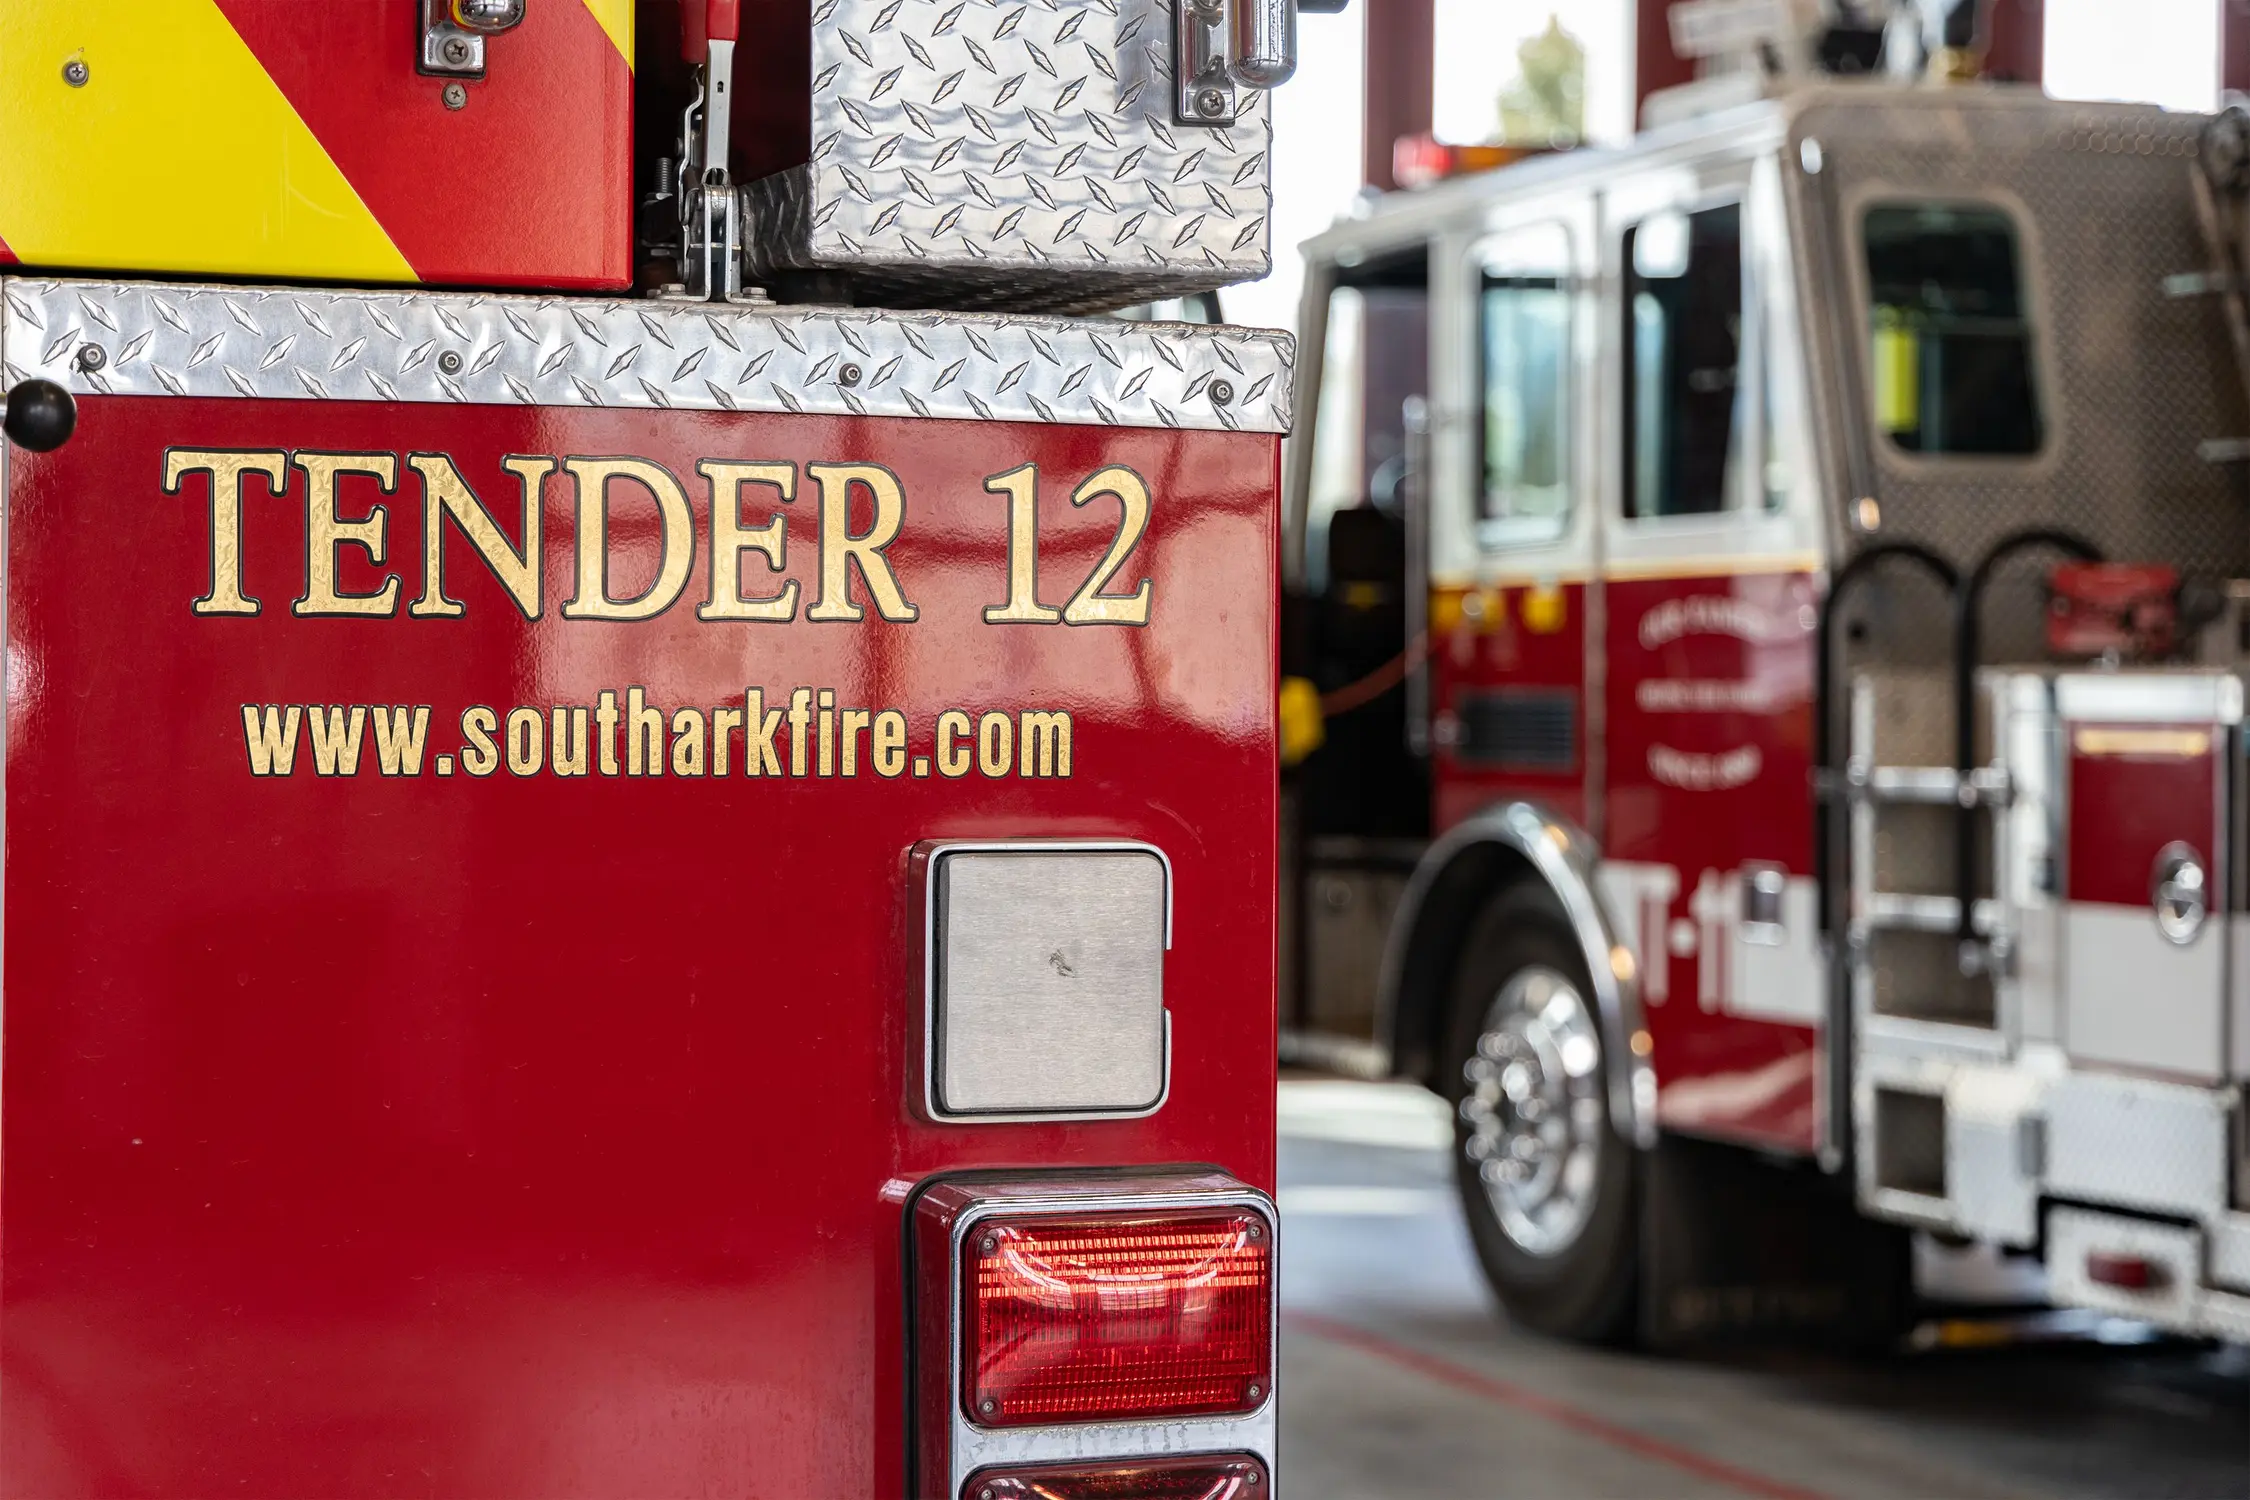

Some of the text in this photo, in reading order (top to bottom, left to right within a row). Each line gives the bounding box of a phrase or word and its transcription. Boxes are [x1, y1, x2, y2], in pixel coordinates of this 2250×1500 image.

[161, 446, 1155, 626] TENDER 12
[241, 685, 1074, 778] www.southarkfire.com
